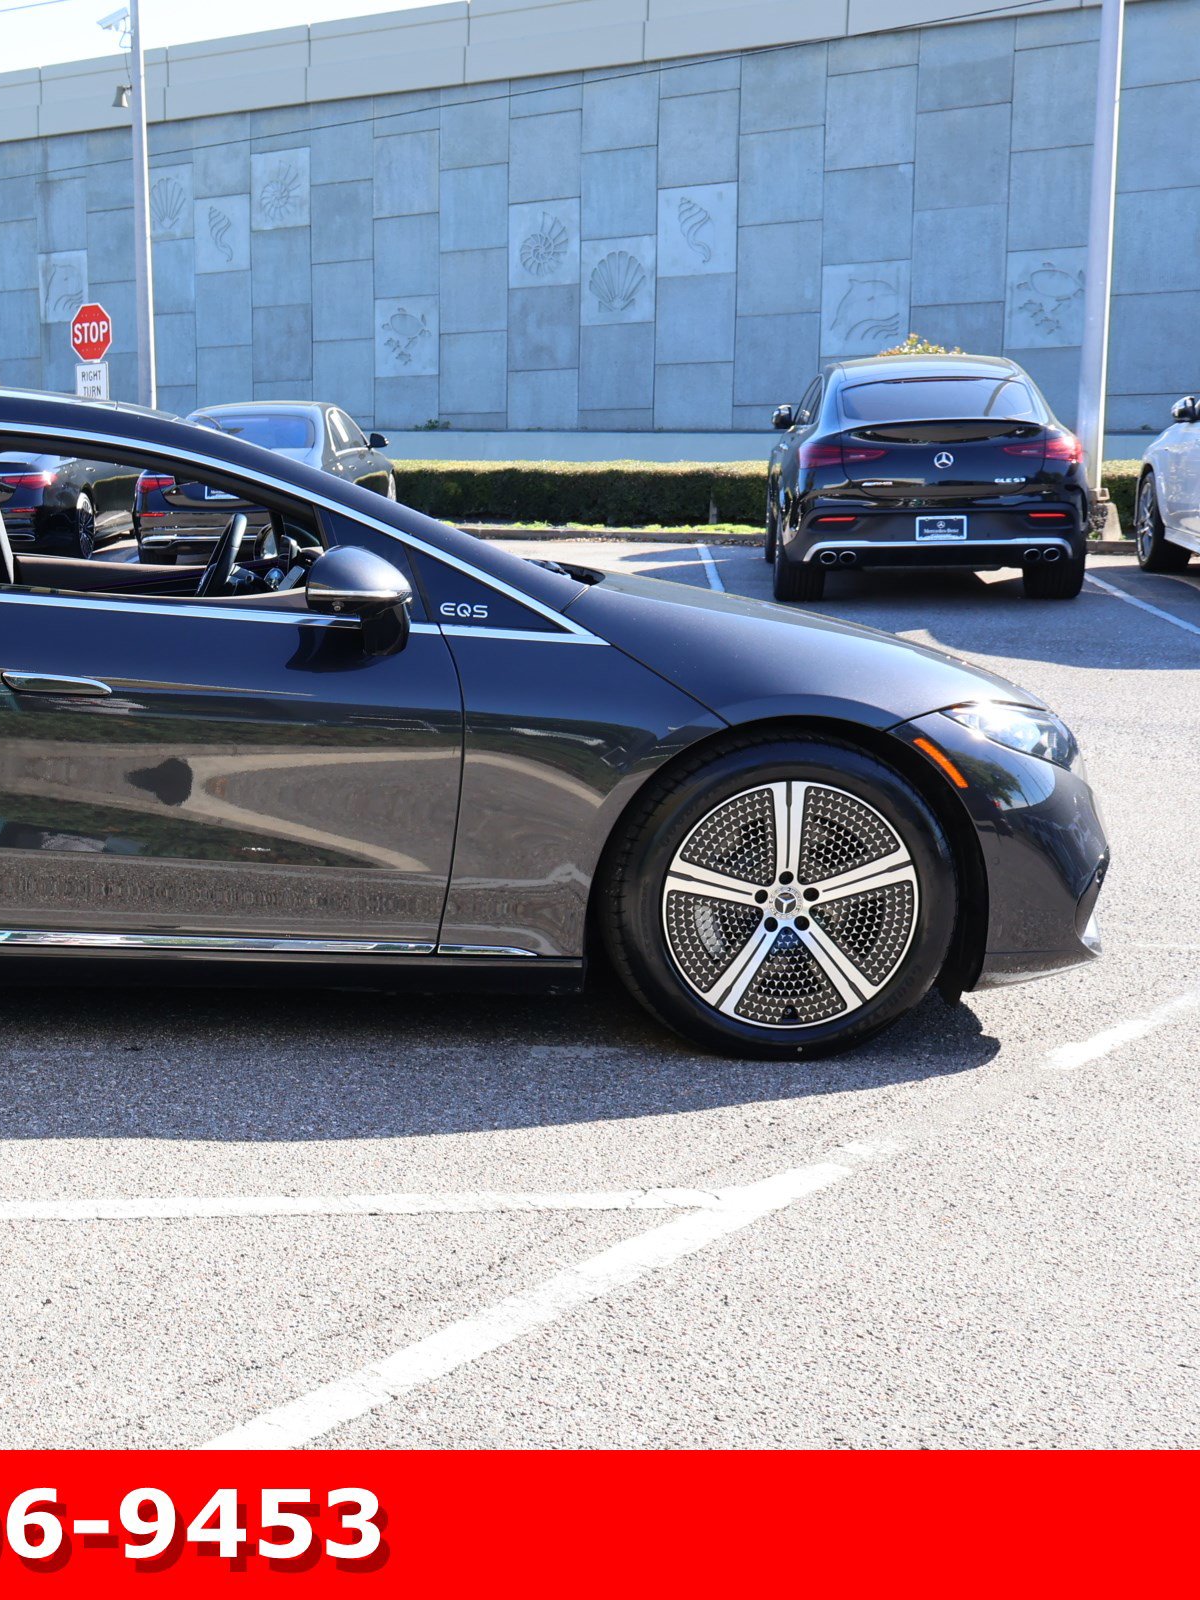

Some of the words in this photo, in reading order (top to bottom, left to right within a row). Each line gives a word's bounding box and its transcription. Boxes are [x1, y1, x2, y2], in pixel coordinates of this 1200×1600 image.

[74, 321, 108, 344] STOP
[81, 370, 101, 382] RIGHT
[83, 385, 102, 397] TURN
[440, 602, 488, 618] EQS
